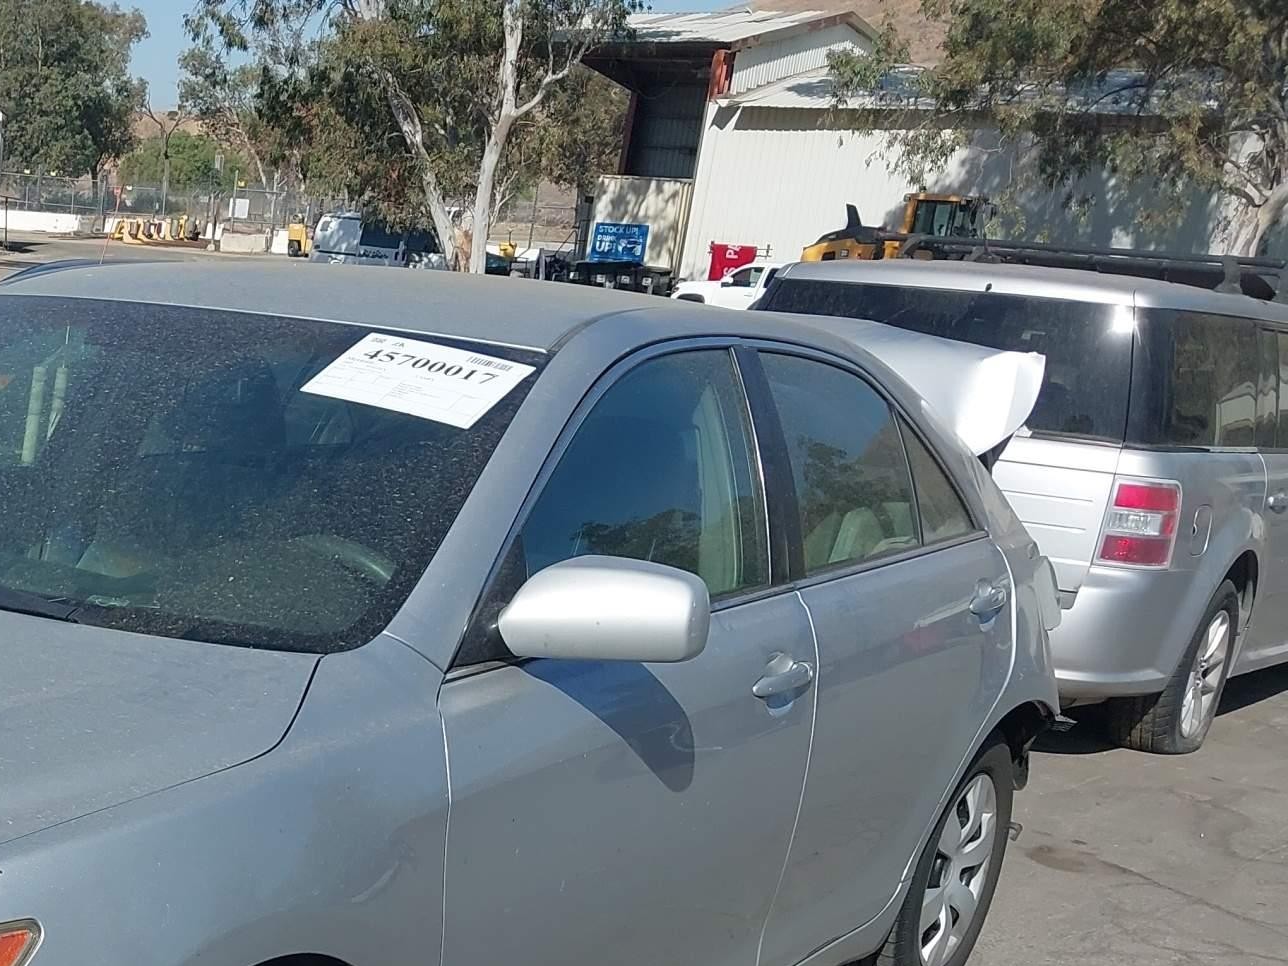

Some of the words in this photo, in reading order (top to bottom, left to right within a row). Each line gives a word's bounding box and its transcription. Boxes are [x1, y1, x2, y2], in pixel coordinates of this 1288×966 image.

[599, 225, 624, 234] STOCK
[596, 240, 617, 252] UP!
[363, 348, 500, 385] 45700017
